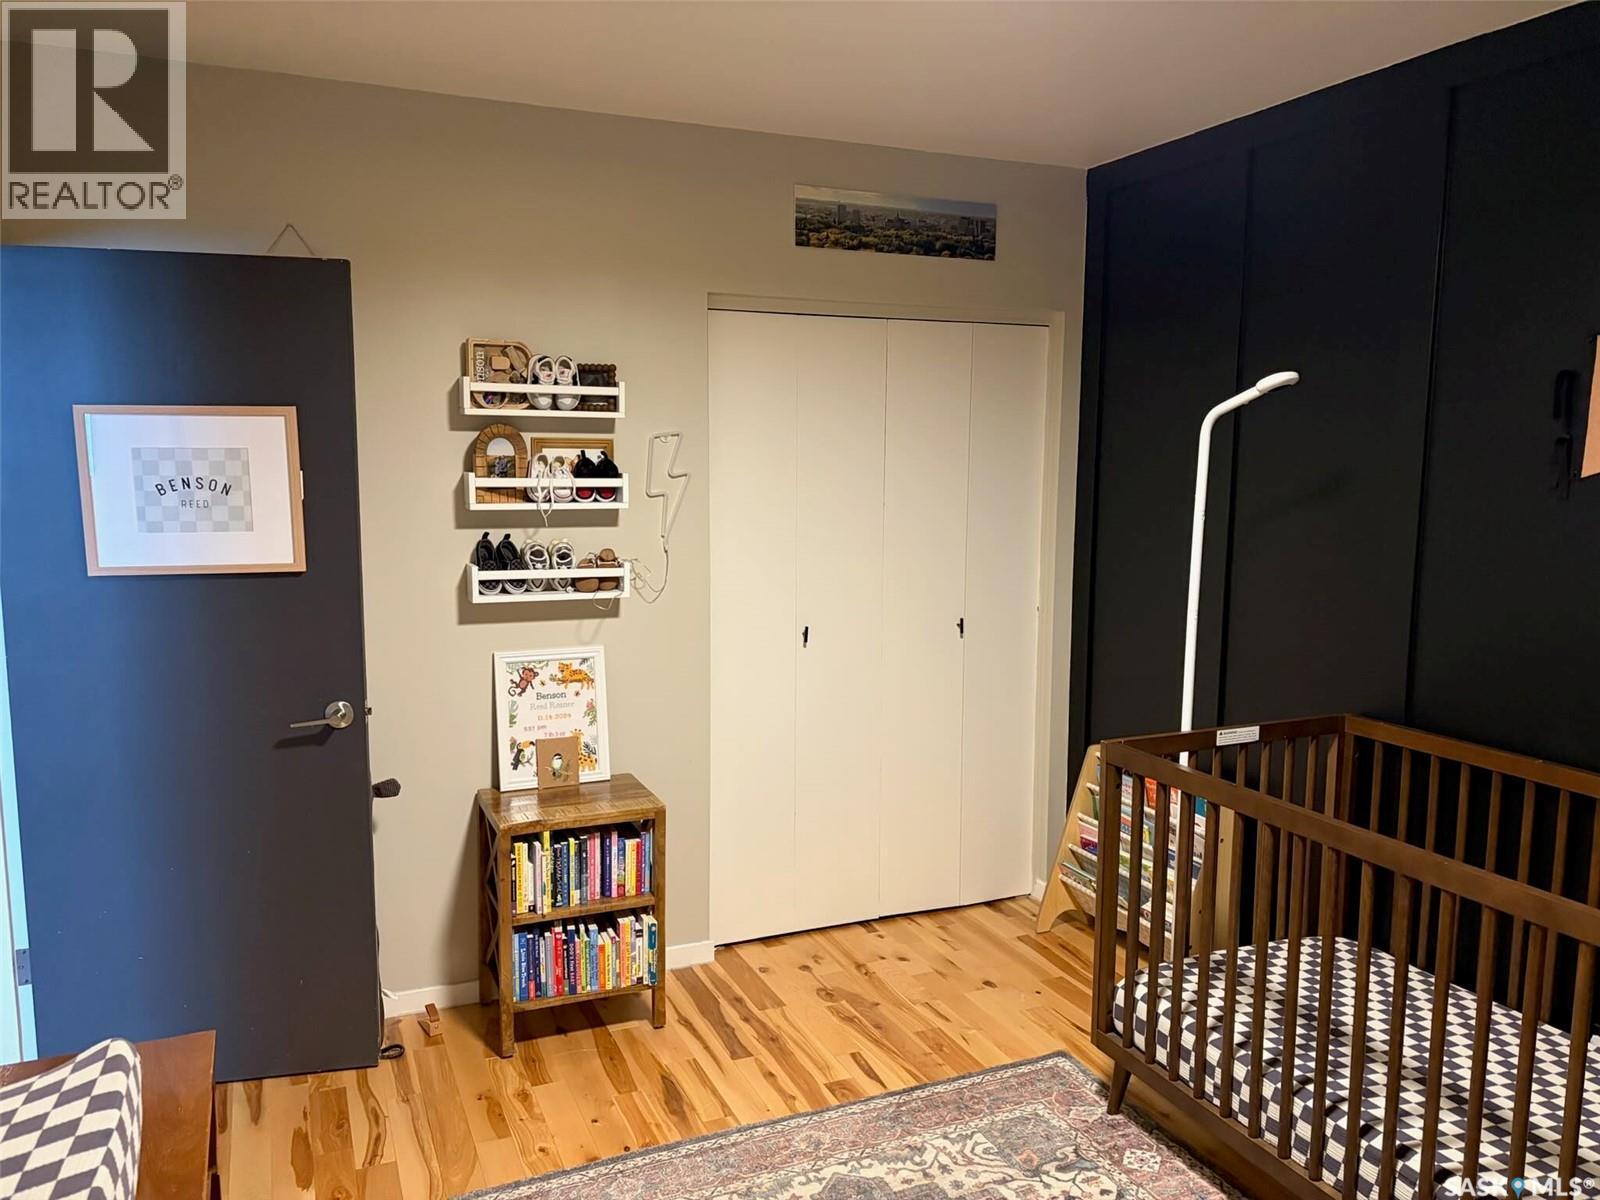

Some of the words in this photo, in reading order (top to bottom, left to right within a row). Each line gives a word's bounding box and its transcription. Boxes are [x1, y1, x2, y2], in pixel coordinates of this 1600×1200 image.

[155, 476, 232, 496] BENSON
[181, 499, 209, 509] REED
[535, 691, 567, 701] Benson
